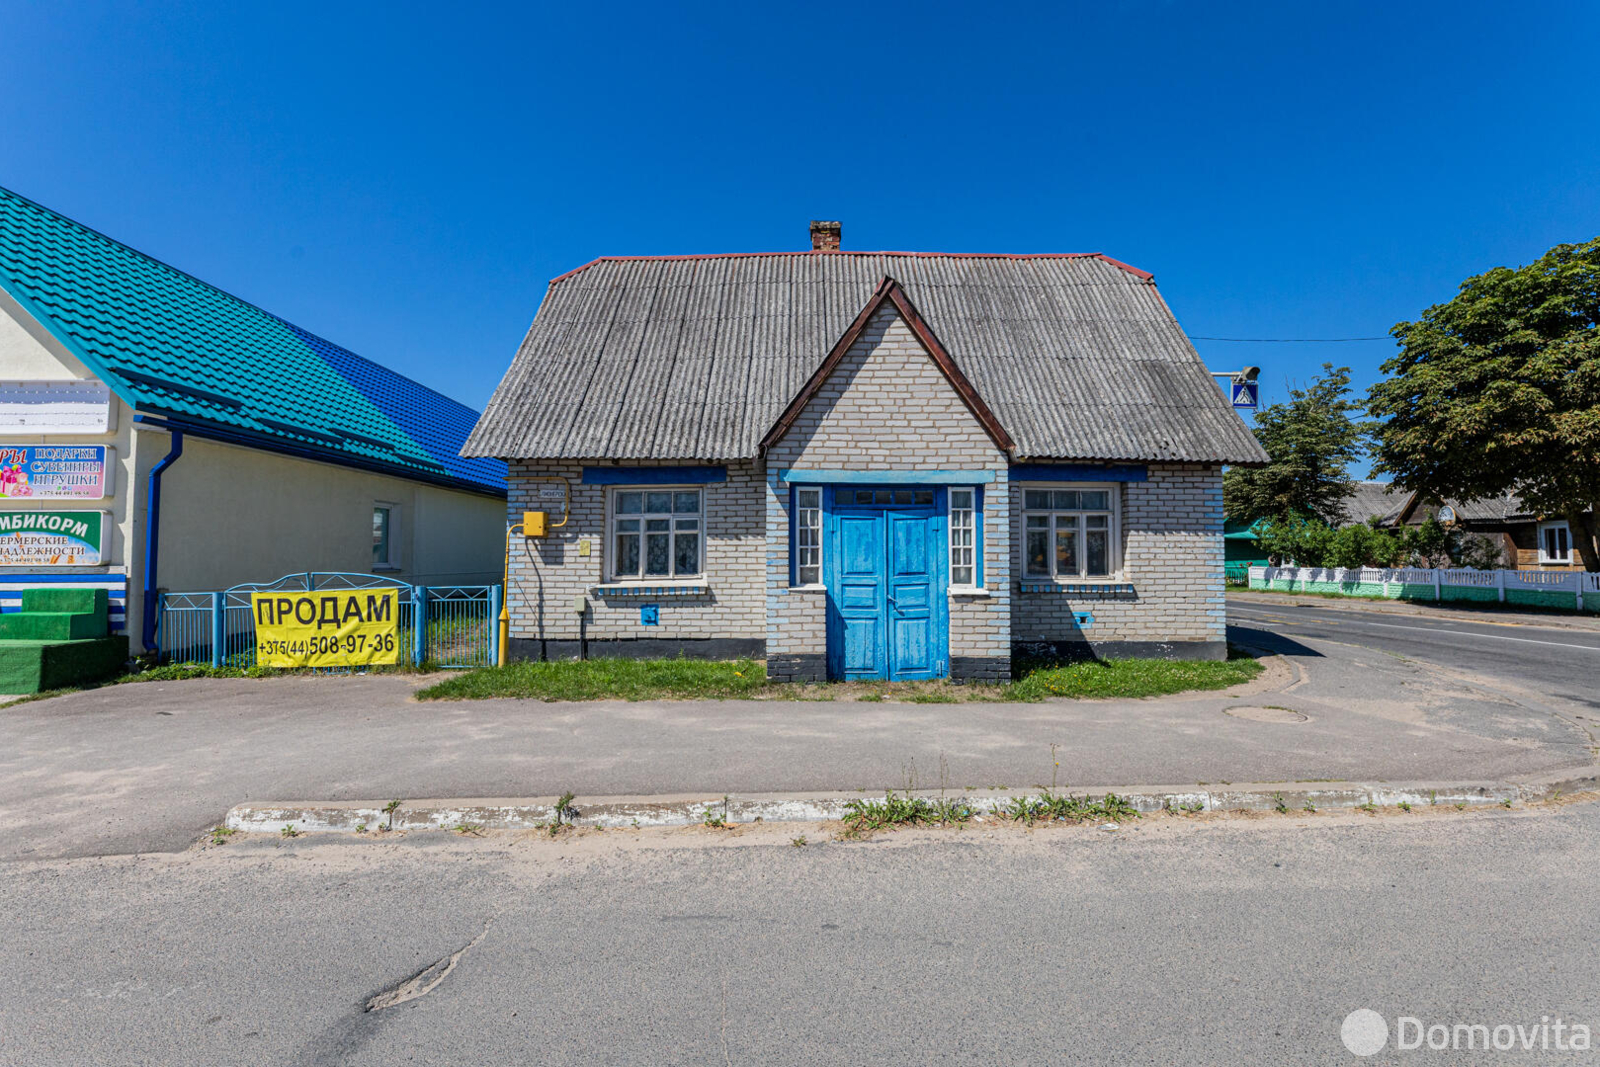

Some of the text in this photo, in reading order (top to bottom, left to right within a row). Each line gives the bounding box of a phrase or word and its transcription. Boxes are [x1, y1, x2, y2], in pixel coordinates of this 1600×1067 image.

[35, 448, 97, 460] ПОДАРКИ
[31, 461, 101, 473] СУВЕНИРЫ
[33, 474, 98, 485] ИГРУШКИ
[0, 536, 68, 545] ЕРМЕРСКИЕ
[257, 595, 391, 629] ПРОДАМ
[259, 634, 394, 660] +375(44)508-97-36
